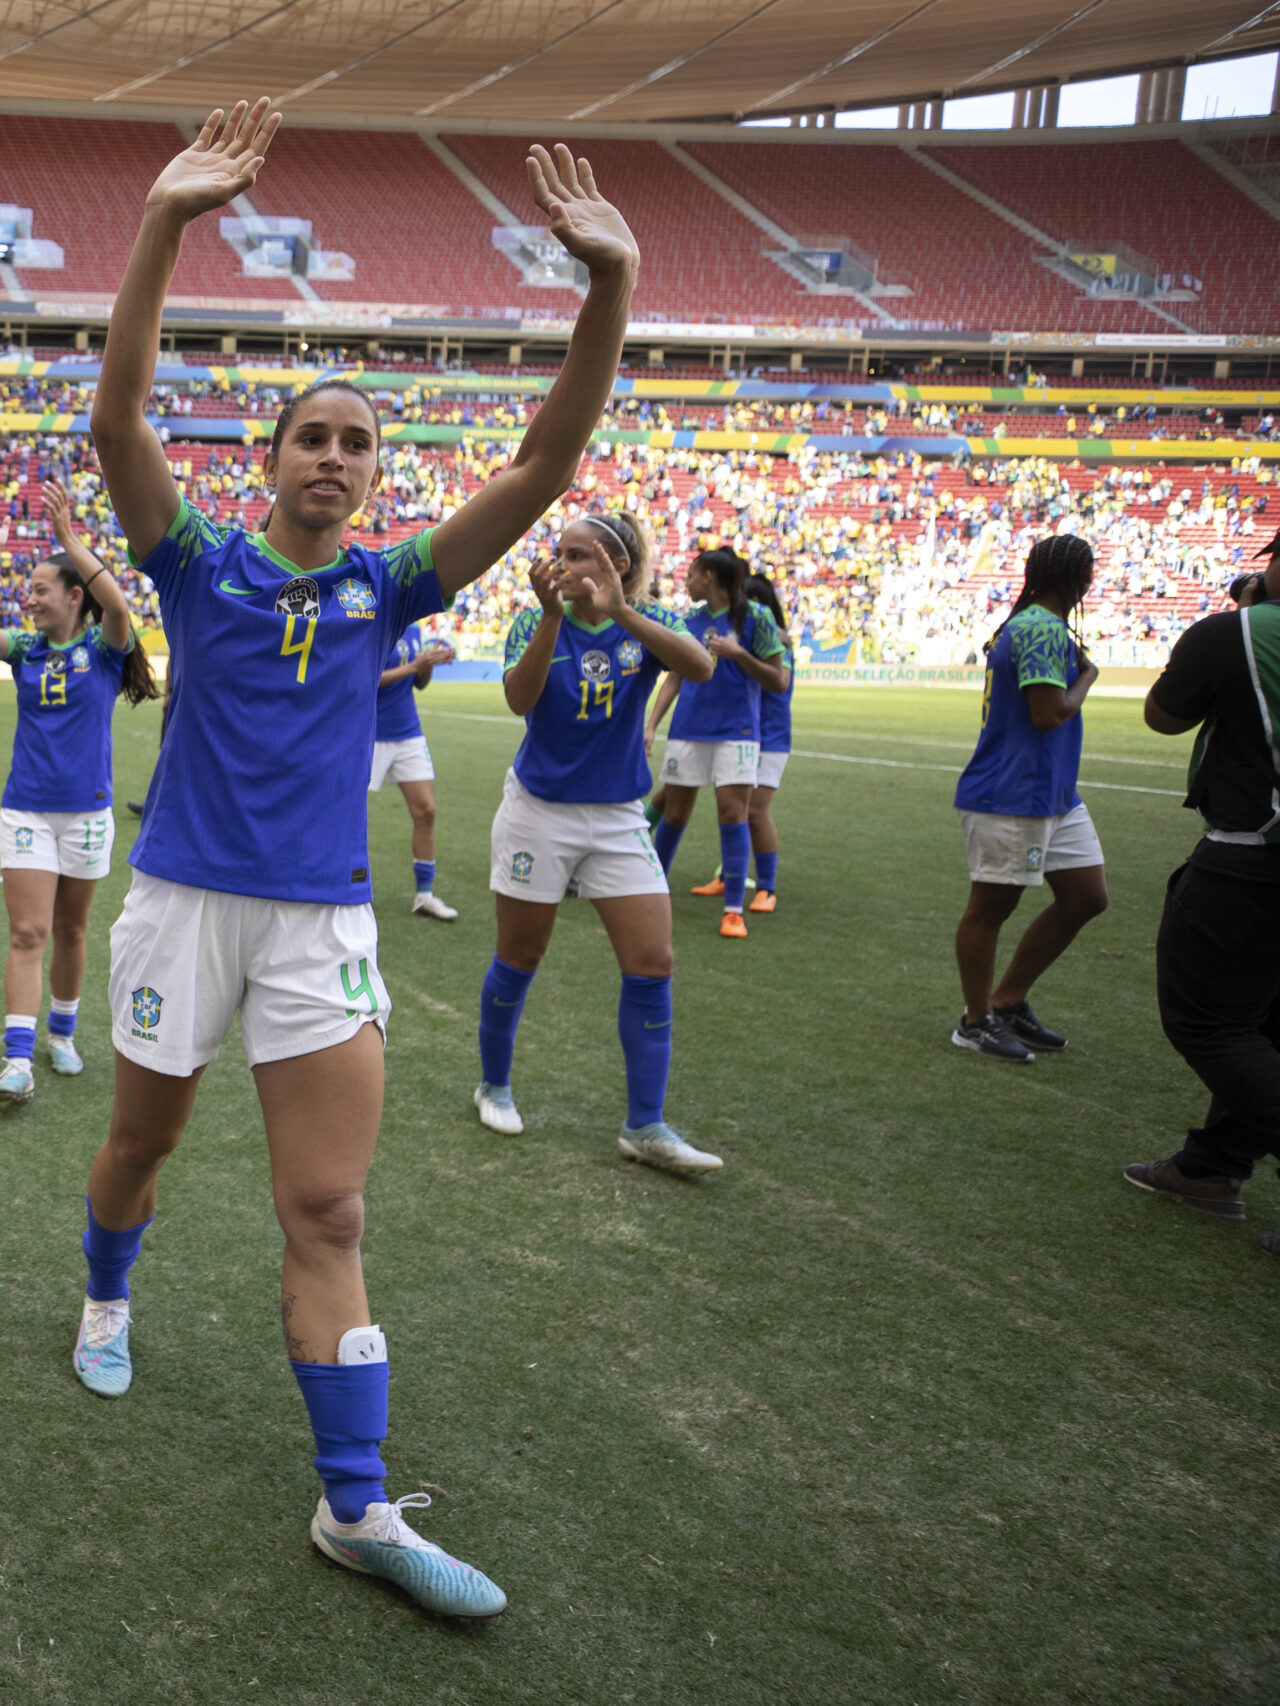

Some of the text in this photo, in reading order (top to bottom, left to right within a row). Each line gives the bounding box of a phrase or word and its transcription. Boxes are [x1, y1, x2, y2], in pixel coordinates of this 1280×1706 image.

[280, 614, 318, 684] 4
[40, 672, 67, 706] 13
[794, 668, 851, 681] MISTOSO
[919, 668, 985, 681] BRASILEIR
[576, 680, 614, 719] 19
[340, 957, 378, 1013] 4
[131, 1028, 159, 1043] BRASIL
